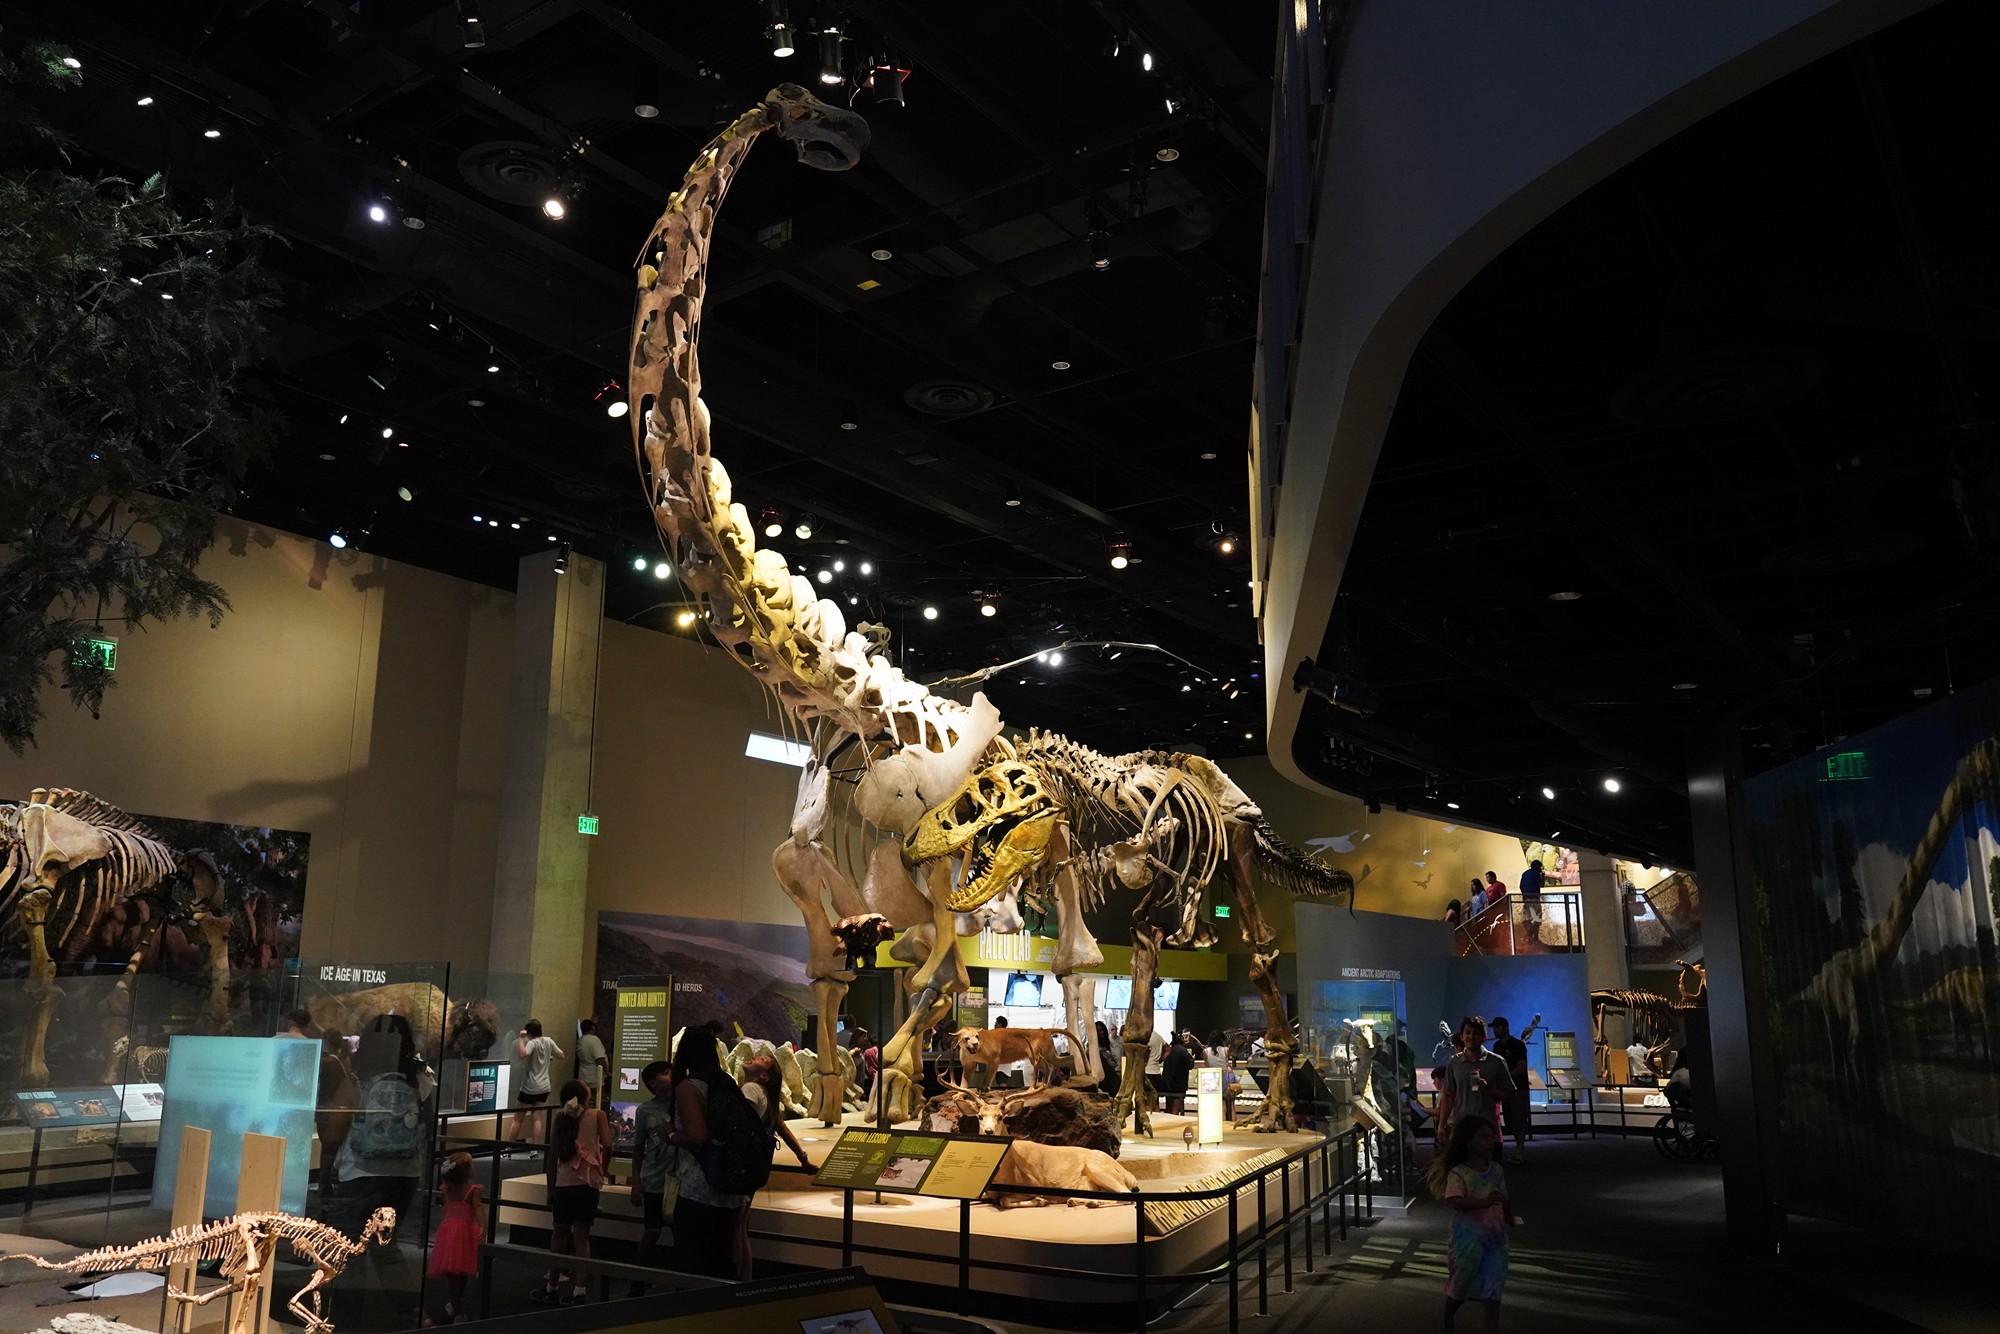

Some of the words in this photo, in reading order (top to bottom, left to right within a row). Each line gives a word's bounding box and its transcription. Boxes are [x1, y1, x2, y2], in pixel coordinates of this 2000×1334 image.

[1013, 929, 1031, 962] LAB
[320, 966, 334, 980] ICE
[335, 967, 351, 982] AGE
[352, 968, 361, 982] IN
[362, 969, 386, 983] TEXAS
[1341, 967, 1359, 977] ANCIENT
[1360, 968, 1374, 978] ARCTIC
[1375, 969, 1400, 979] ADAPTATIONS
[682, 983, 703, 992] HERDS
[637, 992, 647, 1007] AND
[647, 992, 666, 1007] HUNTED
[866, 1132, 892, 1145] LESSONS
